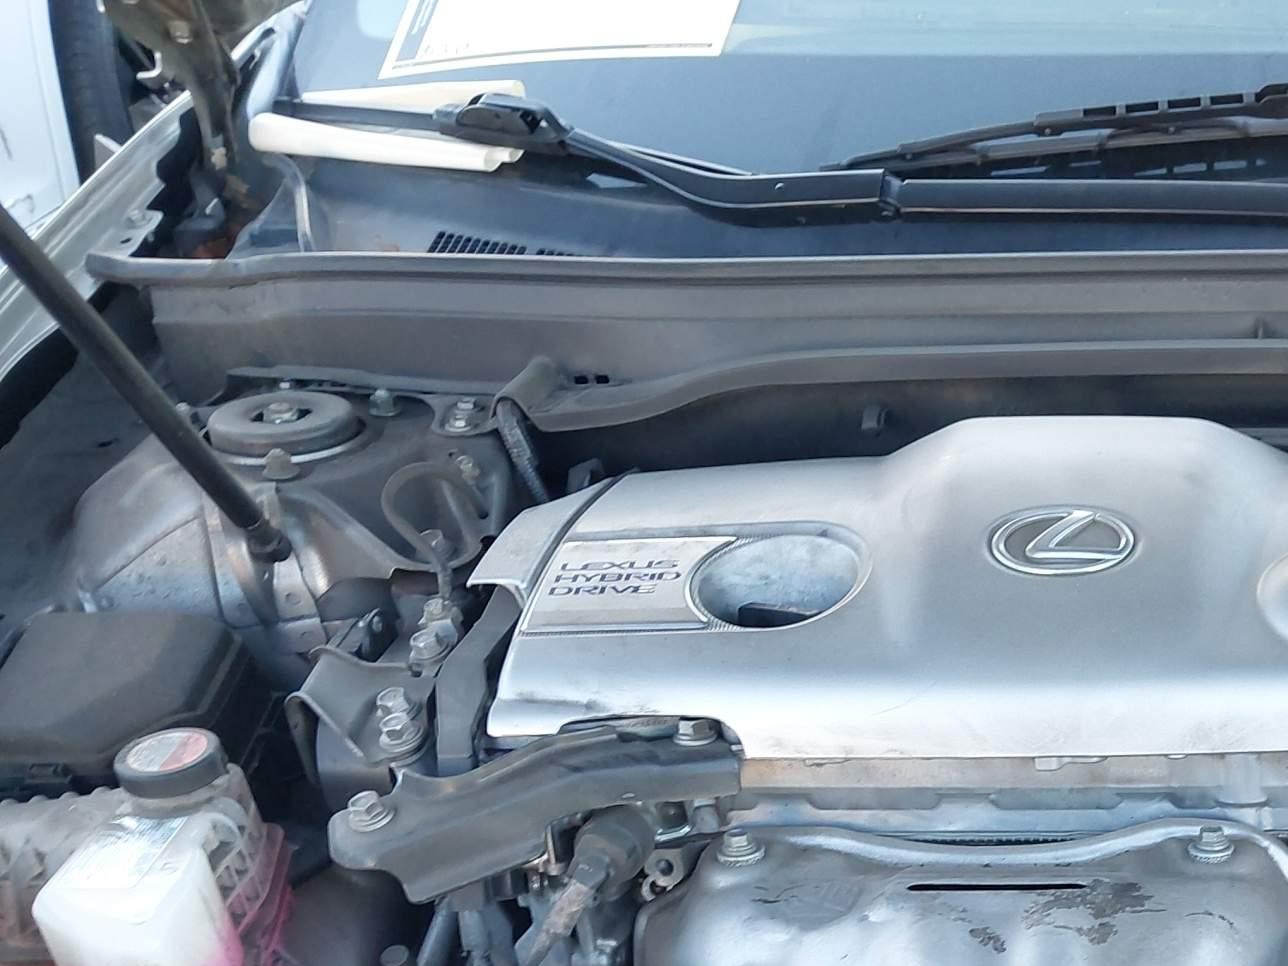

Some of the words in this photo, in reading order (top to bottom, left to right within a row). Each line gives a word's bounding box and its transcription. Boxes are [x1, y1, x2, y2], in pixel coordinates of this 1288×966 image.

[560, 559, 681, 571] LEXUS
[554, 571, 682, 584] HYBRID
[548, 583, 657, 596] DRIVE
